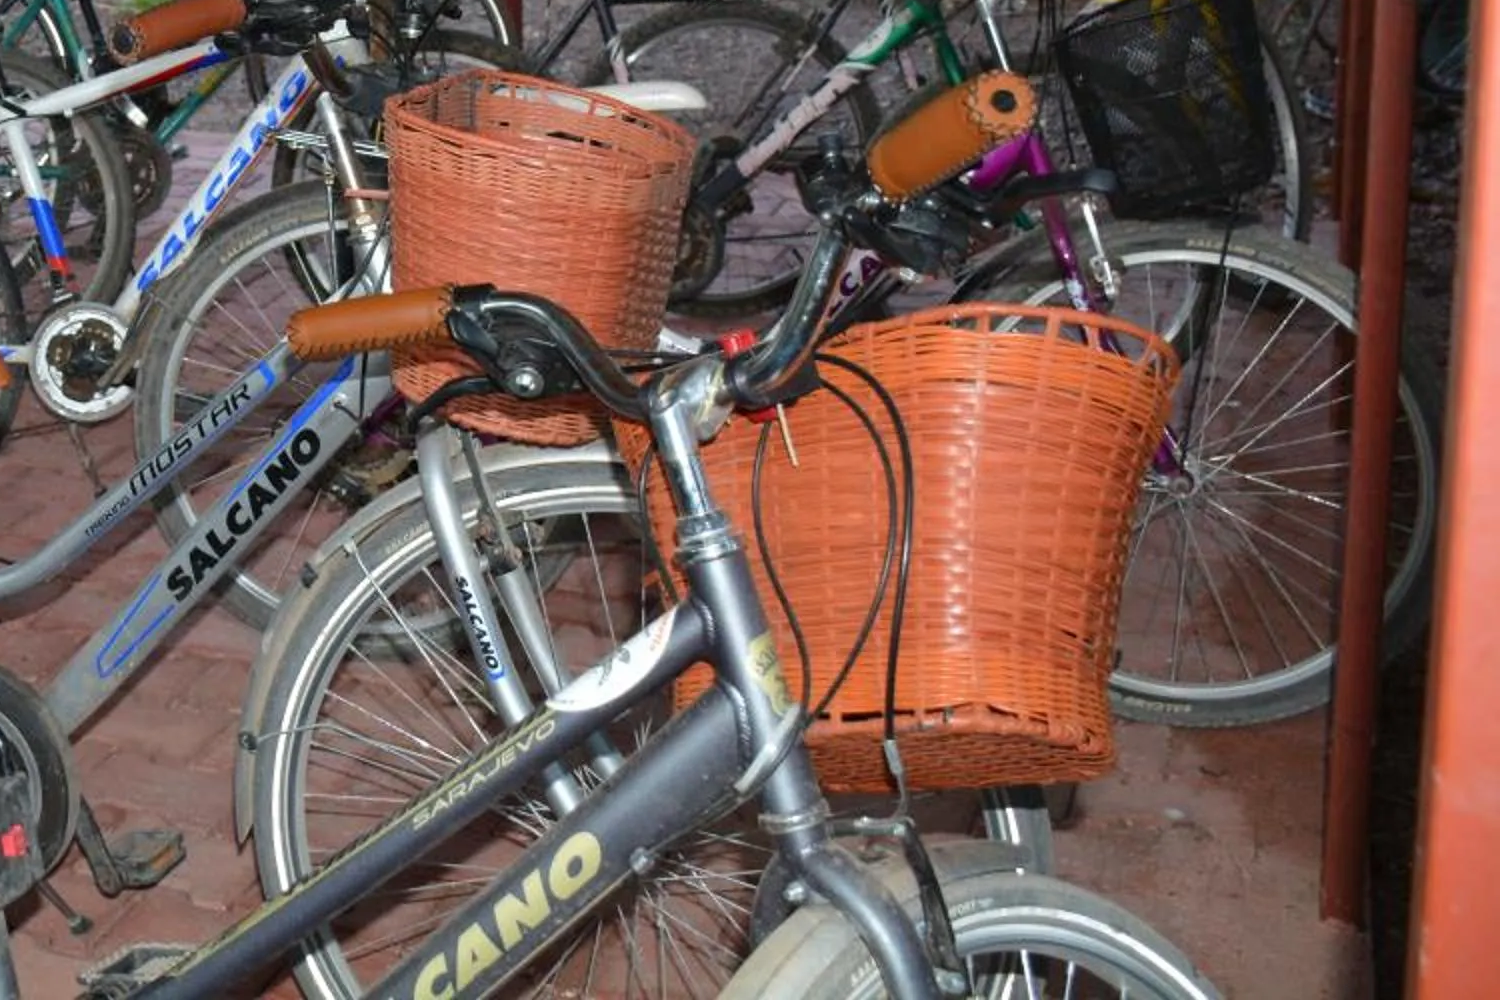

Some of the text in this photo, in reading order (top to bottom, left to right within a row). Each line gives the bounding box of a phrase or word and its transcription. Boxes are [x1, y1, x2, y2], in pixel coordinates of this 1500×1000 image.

[138, 71, 307, 292] SALCANO
[128, 381, 251, 496] MOSTAR
[166, 427, 321, 602] SALCANO
[455, 576, 499, 669] SALCANO
[412, 717, 557, 831] SARAJEVO
[392, 831, 603, 1000] CANO
